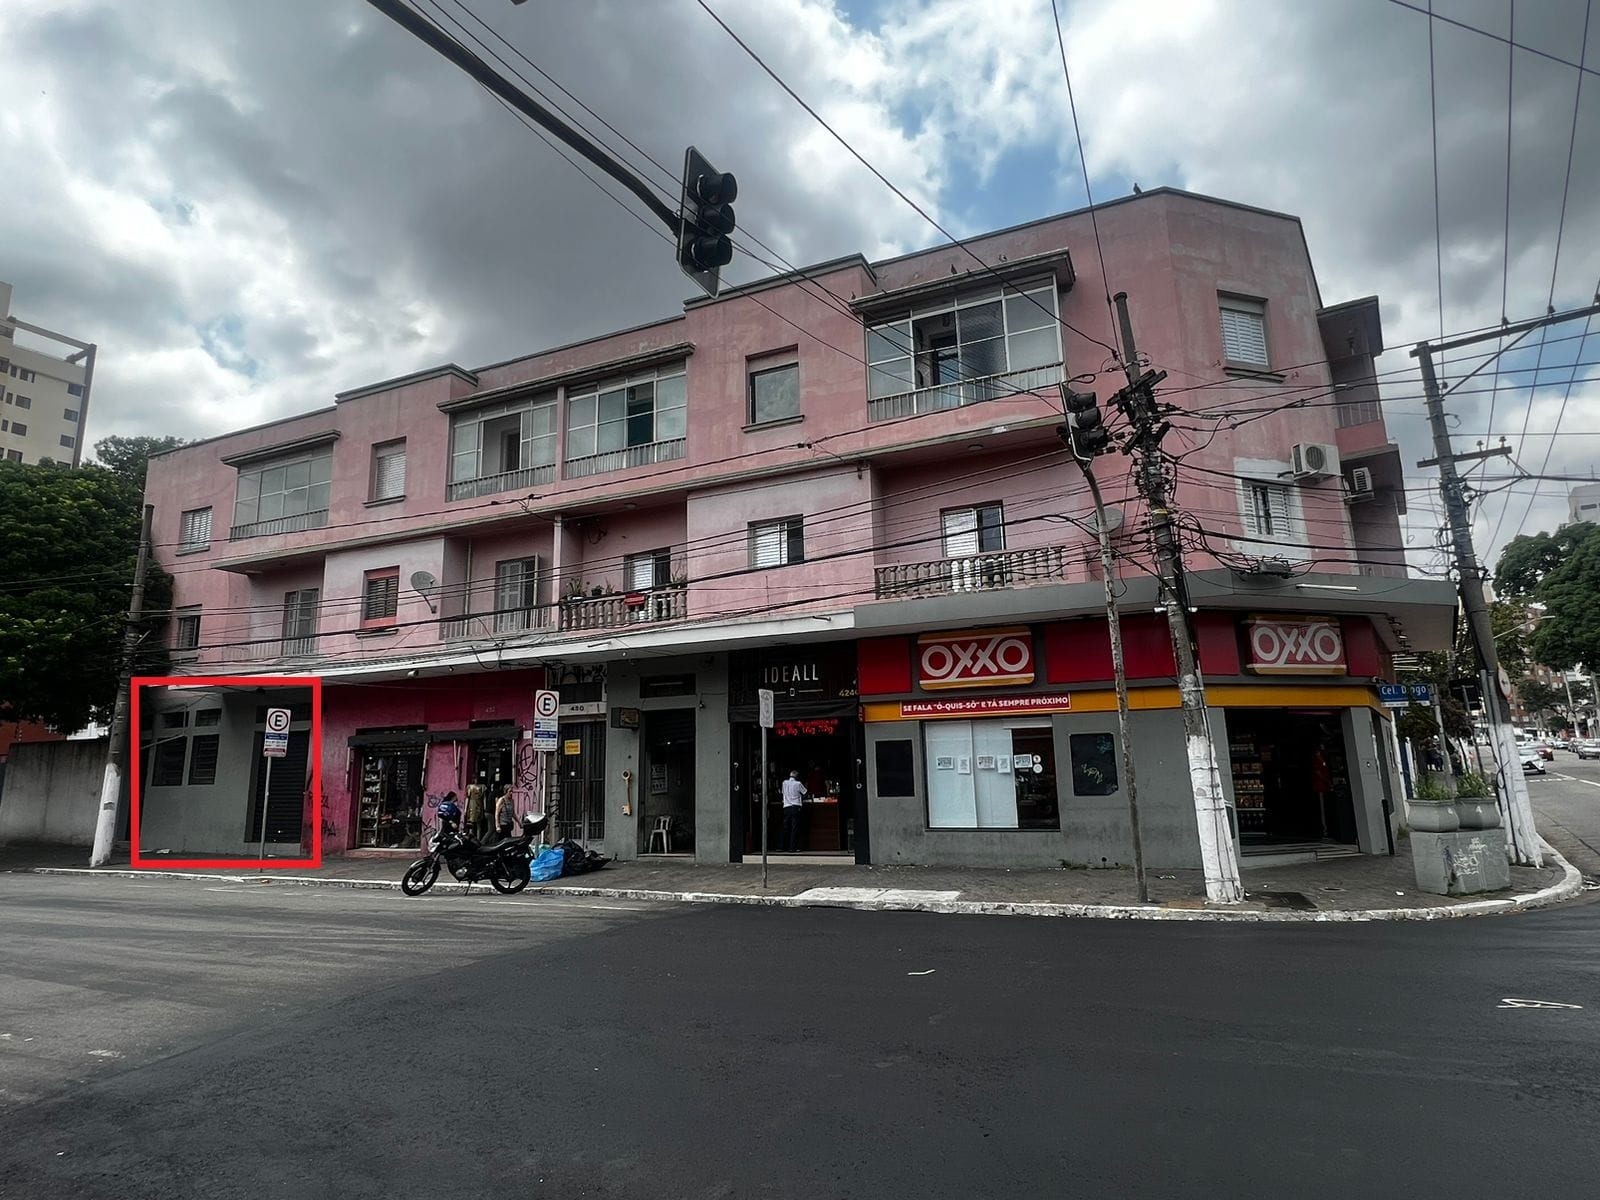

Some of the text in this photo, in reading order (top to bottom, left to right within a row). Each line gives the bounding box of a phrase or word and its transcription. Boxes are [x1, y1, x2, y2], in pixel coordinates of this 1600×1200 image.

[1253, 623, 1341, 665] OXXO
[921, 637, 1030, 680] OXXO
[764, 664, 819, 684] IDEALL
[543, 697, 552, 711] E
[913, 703, 933, 712] FALA
[987, 698, 998, 708] TÁ
[999, 698, 1030, 708] SEMPRE
[1030, 696, 1068, 706] PRÓXIMO
[275, 714, 283, 727] E
